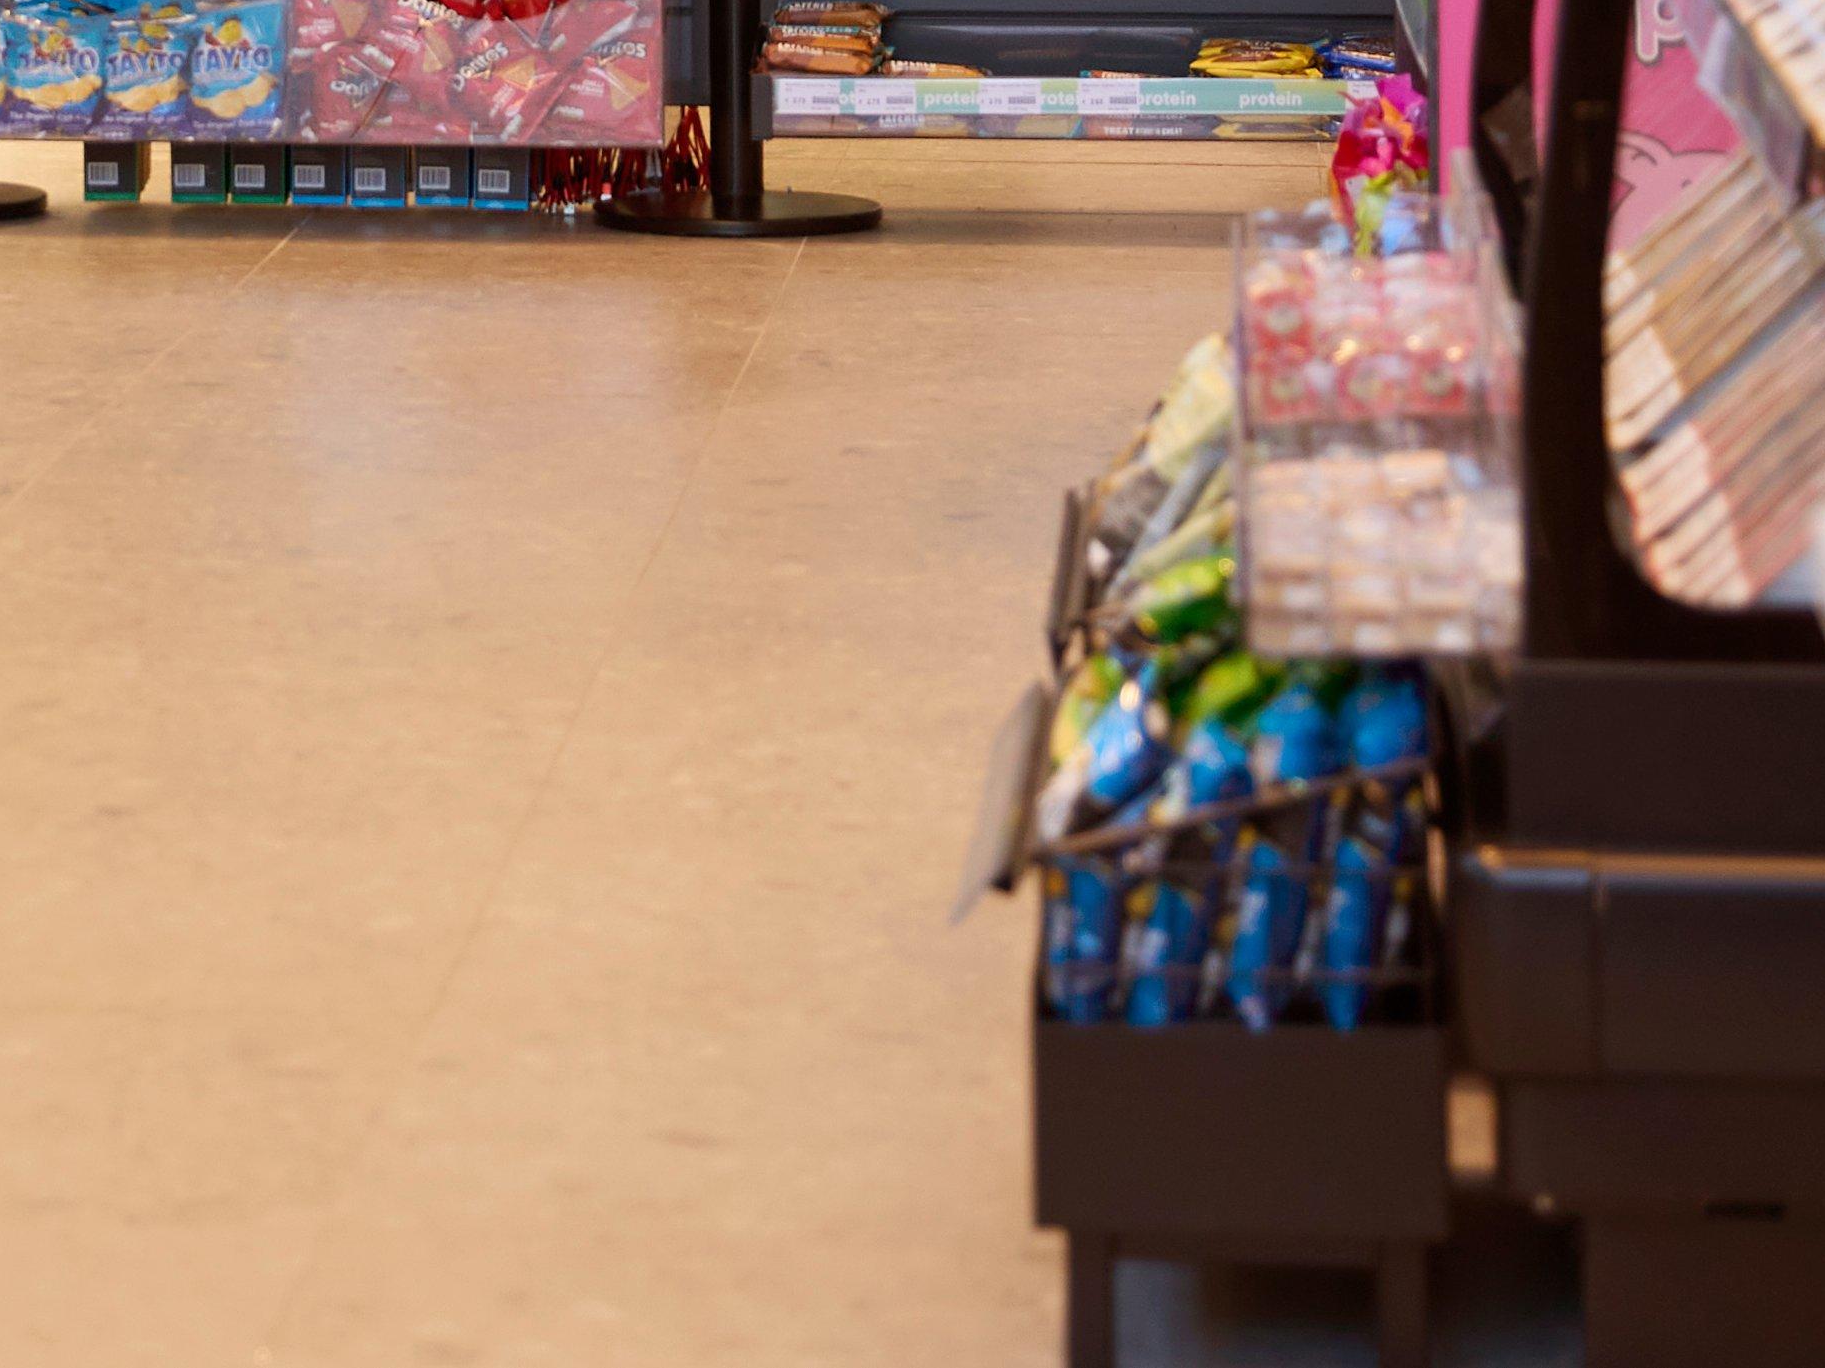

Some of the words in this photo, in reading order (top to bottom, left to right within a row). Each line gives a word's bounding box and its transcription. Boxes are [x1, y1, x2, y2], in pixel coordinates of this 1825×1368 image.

[452, 42, 509, 92] Doritos
[924, 91, 979, 108] protei
[1239, 90, 1303, 108] protein
